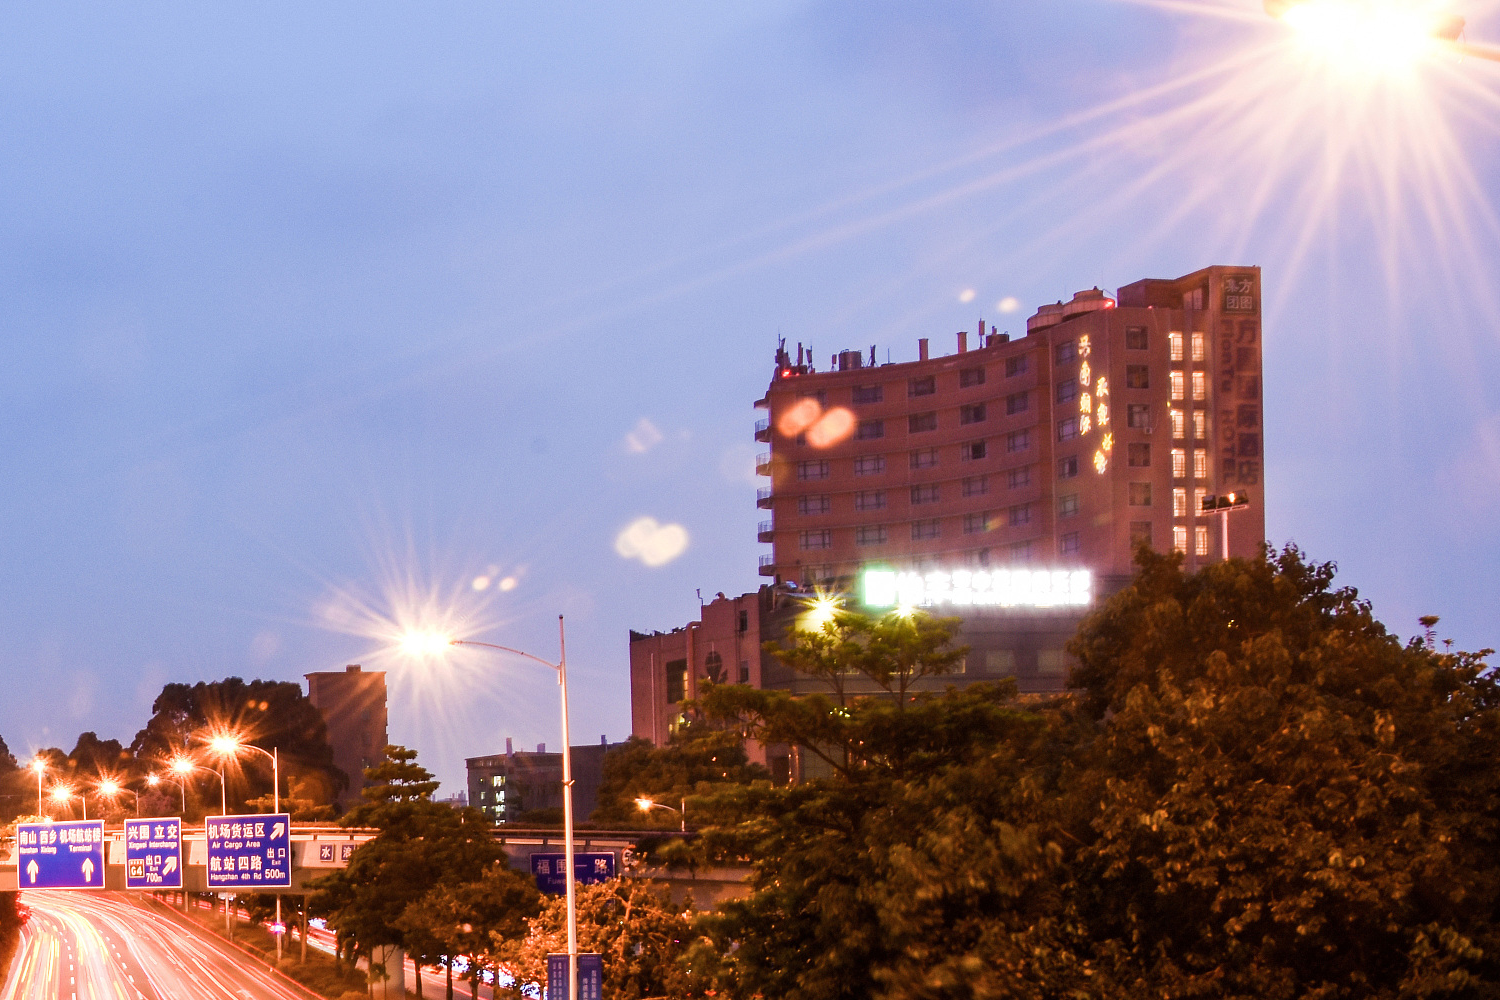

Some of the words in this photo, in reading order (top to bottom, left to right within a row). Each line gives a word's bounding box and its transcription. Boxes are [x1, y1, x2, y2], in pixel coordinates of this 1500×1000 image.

[208, 823, 265, 839] 机场货运区
[212, 841, 221, 849] Air
[224, 840, 243, 850] Cargo
[245, 839, 261, 848] Area
[266, 847, 285, 859] 出口
[145, 855, 162, 866] 出口
[210, 855, 262, 871] 航站四路
[130, 866, 143, 876] G4
[264, 869, 286, 879] 500m
[145, 872, 163, 883] 700m
[210, 873, 238, 882] Hangzhan
